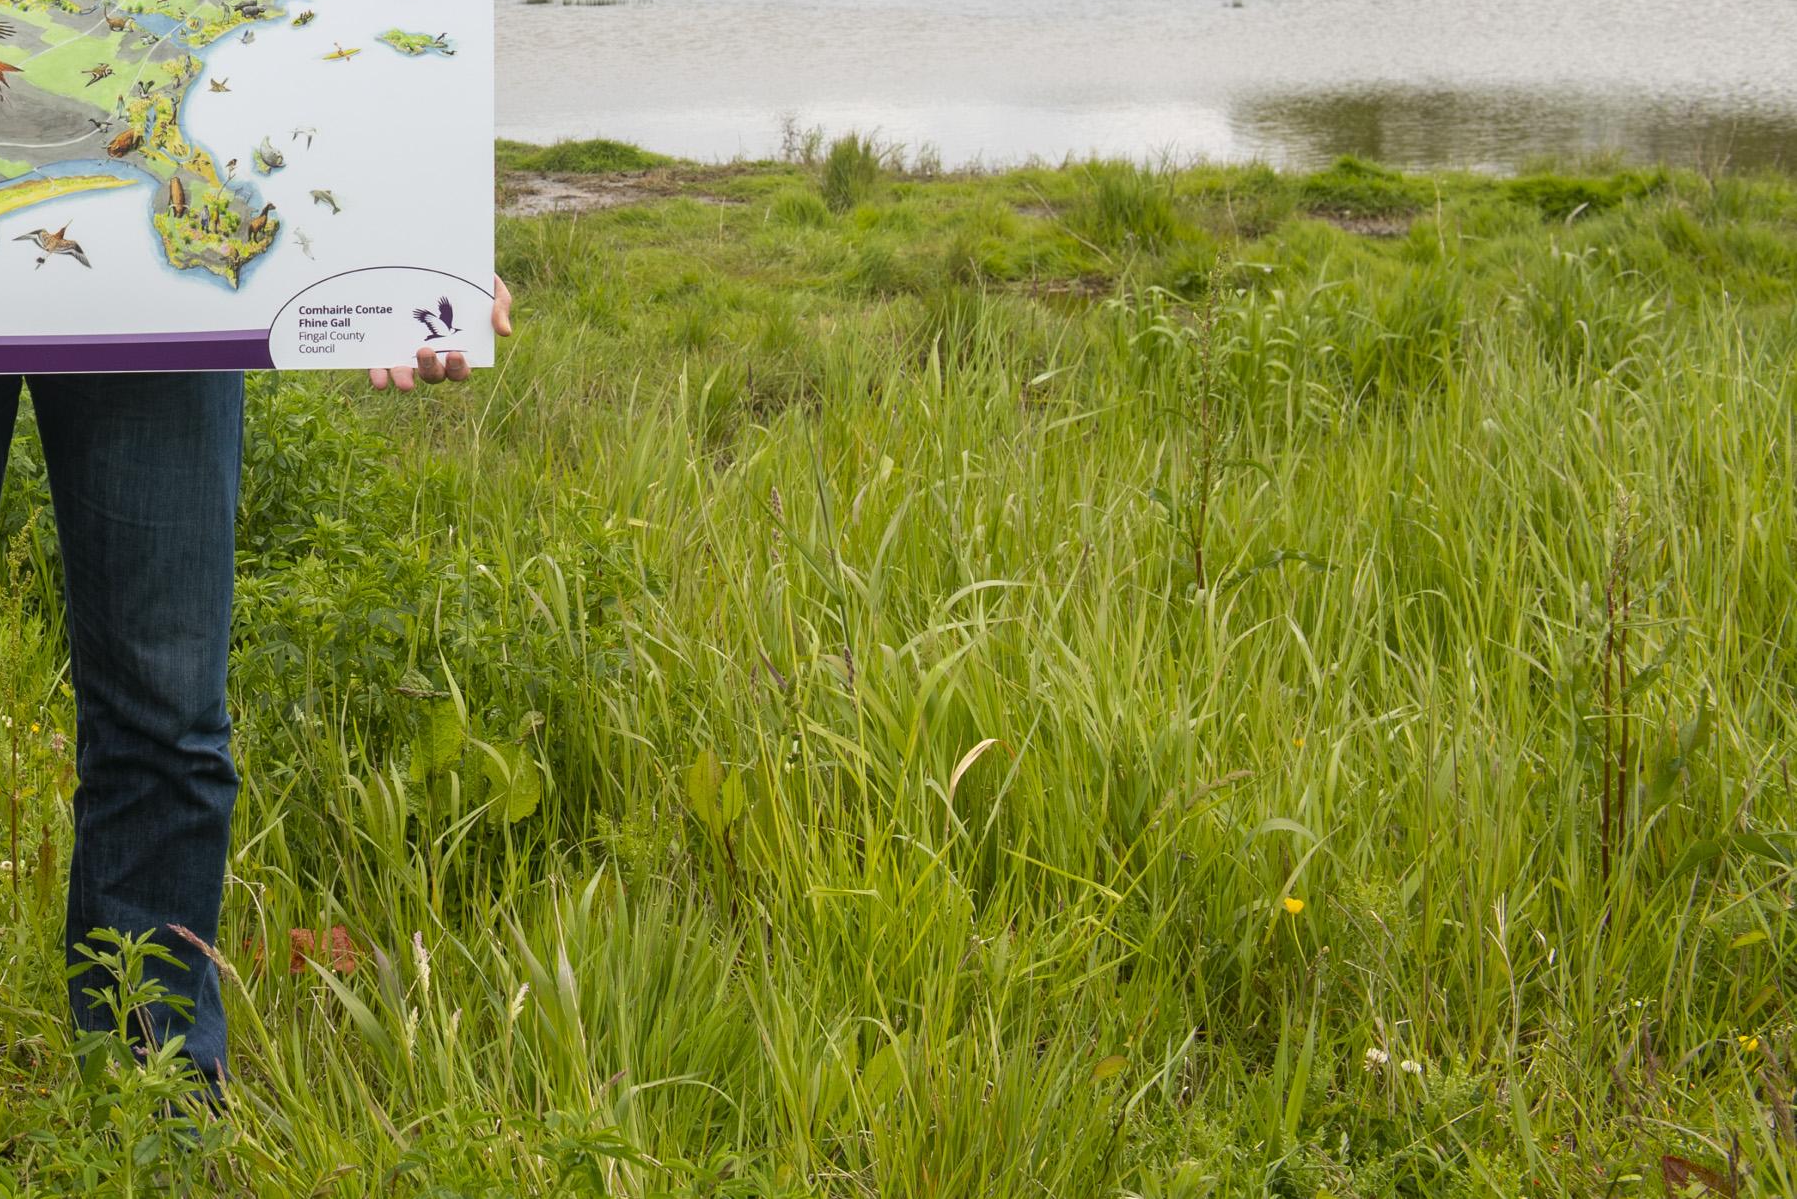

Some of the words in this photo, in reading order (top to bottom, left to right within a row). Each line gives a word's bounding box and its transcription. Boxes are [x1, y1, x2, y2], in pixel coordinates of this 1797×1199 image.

[298, 304, 354, 315] Comhairle
[355, 304, 393, 315] Contae
[298, 318, 329, 328] Fhine
[330, 317, 351, 328] Gall
[298, 330, 328, 343] Fingal
[329, 331, 366, 343] County
[298, 343, 336, 354] Council
